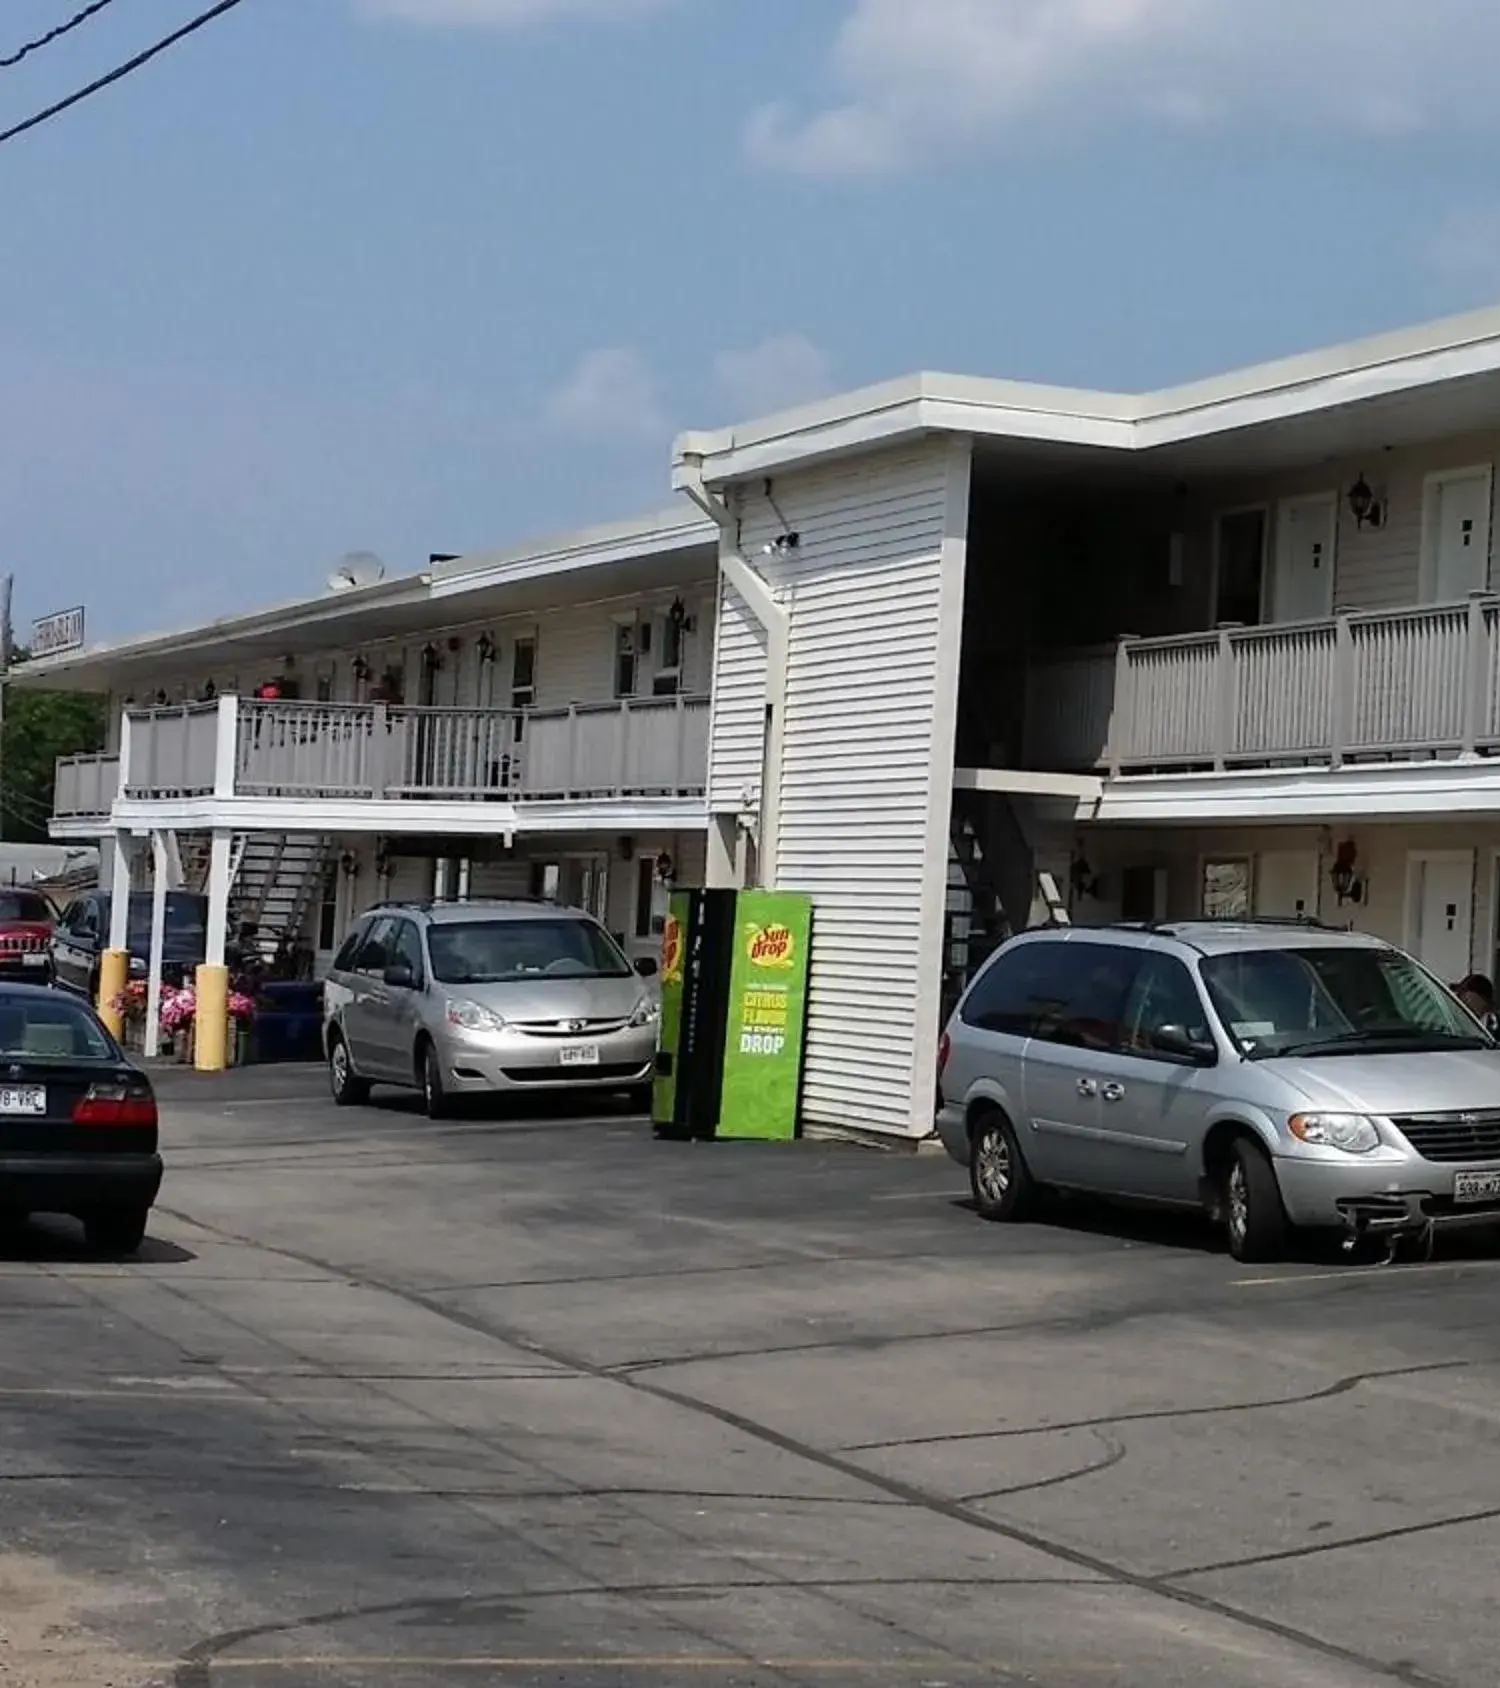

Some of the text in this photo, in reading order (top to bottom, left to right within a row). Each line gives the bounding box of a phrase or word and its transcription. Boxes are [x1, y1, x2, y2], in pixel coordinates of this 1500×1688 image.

[756, 924, 789, 942] Sun
[751, 937, 787, 959] Drop
[743, 992, 787, 1009] CITRUS
[739, 1033, 785, 1054] DROP
